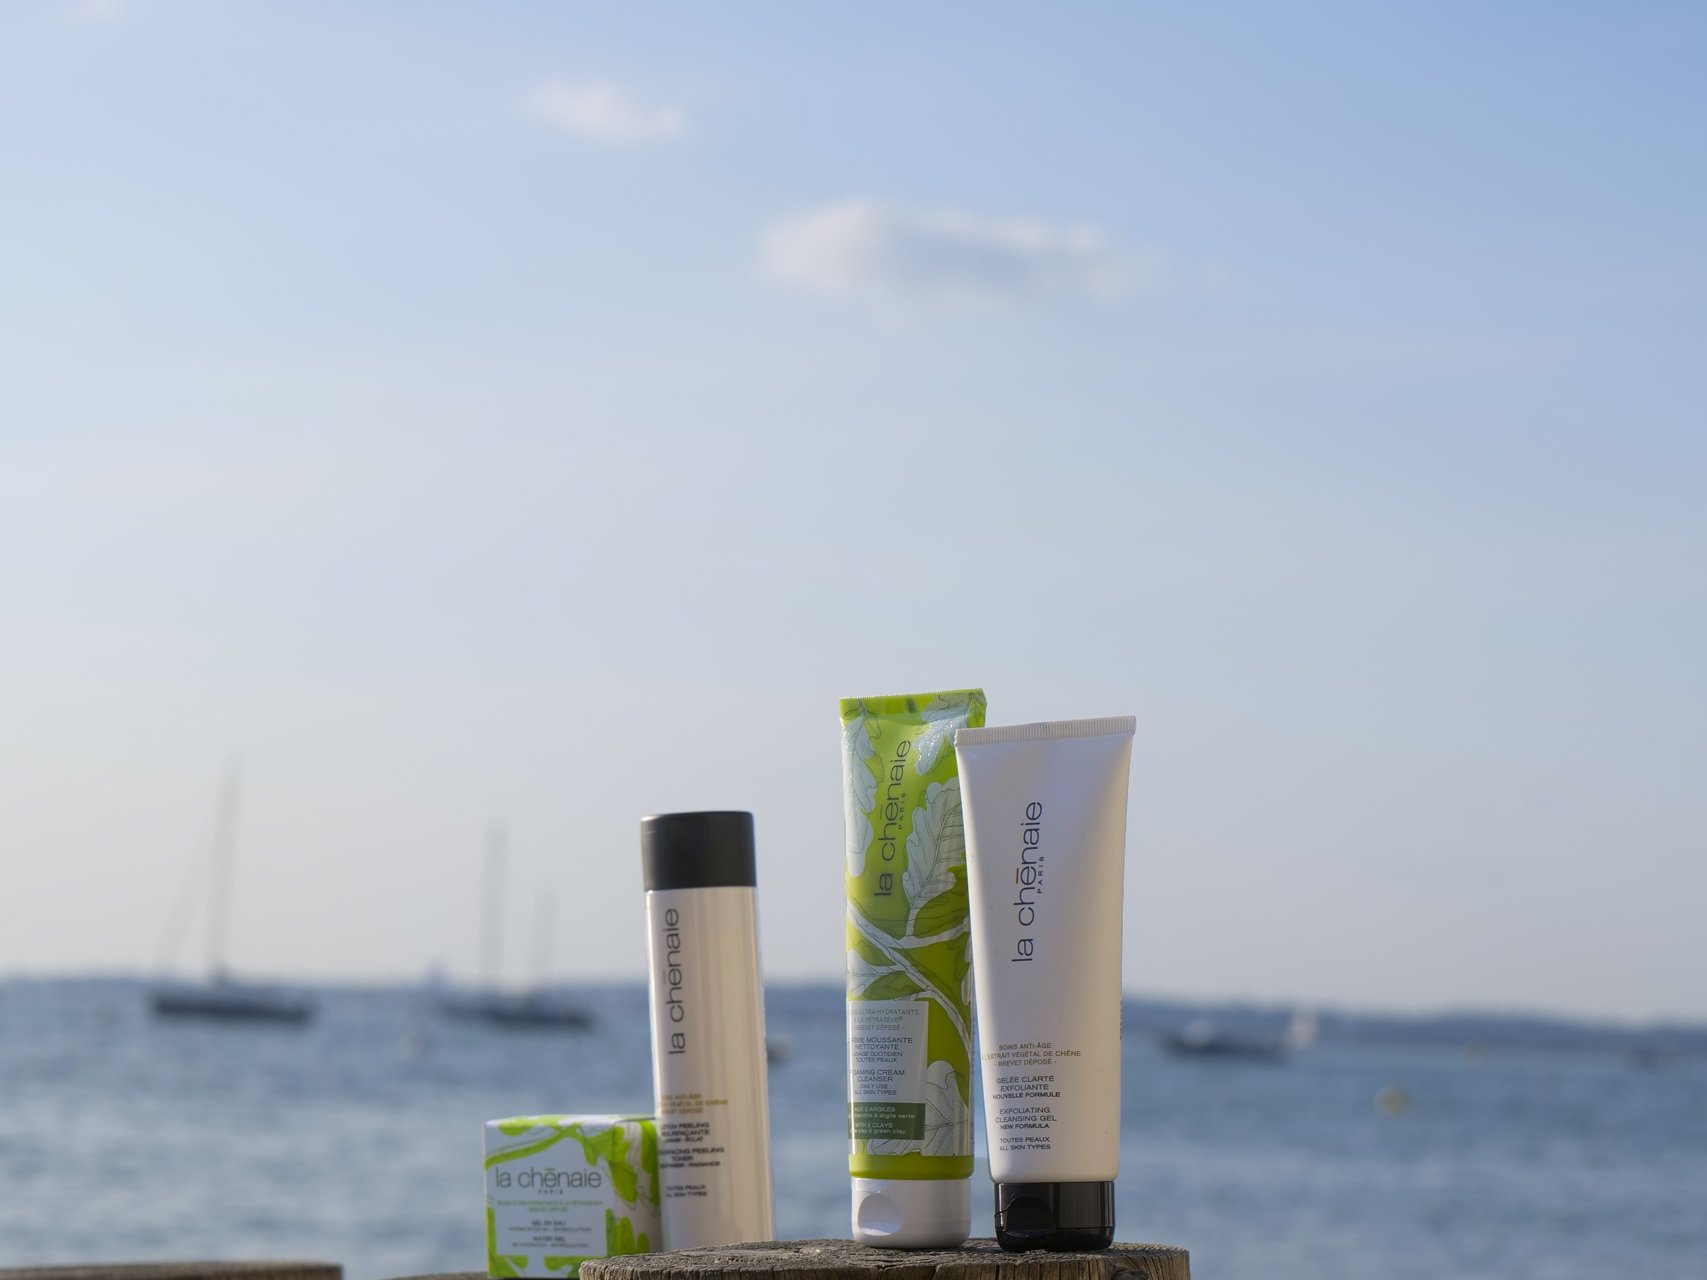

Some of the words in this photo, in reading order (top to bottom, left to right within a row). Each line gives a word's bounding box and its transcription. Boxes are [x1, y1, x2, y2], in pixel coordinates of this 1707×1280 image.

[1036, 856, 1045, 894] PARIS
[874, 873, 894, 896] la
[1011, 938, 1034, 962] la
[668, 1032, 686, 1054] la
[998, 1043, 1018, 1051] SOINS
[1012, 1050, 1041, 1058] VÉGÉTAL
[1055, 1049, 1081, 1057] CHÊNE
[998, 1059, 1024, 1067] BREVET
[1024, 1058, 1052, 1066] DÉPOSÉ
[996, 1076, 1019, 1084] GELÉE
[1021, 1075, 1055, 1083] CLARTÉ
[1000, 1083, 1049, 1092] EXFOLIANTE
[993, 1092, 1023, 1100] NOUVELLE
[1000, 1107, 1050, 1115] EXFOLIATING
[995, 1115, 1037, 1123] CLEANSING
[495, 1167, 511, 1188] la
